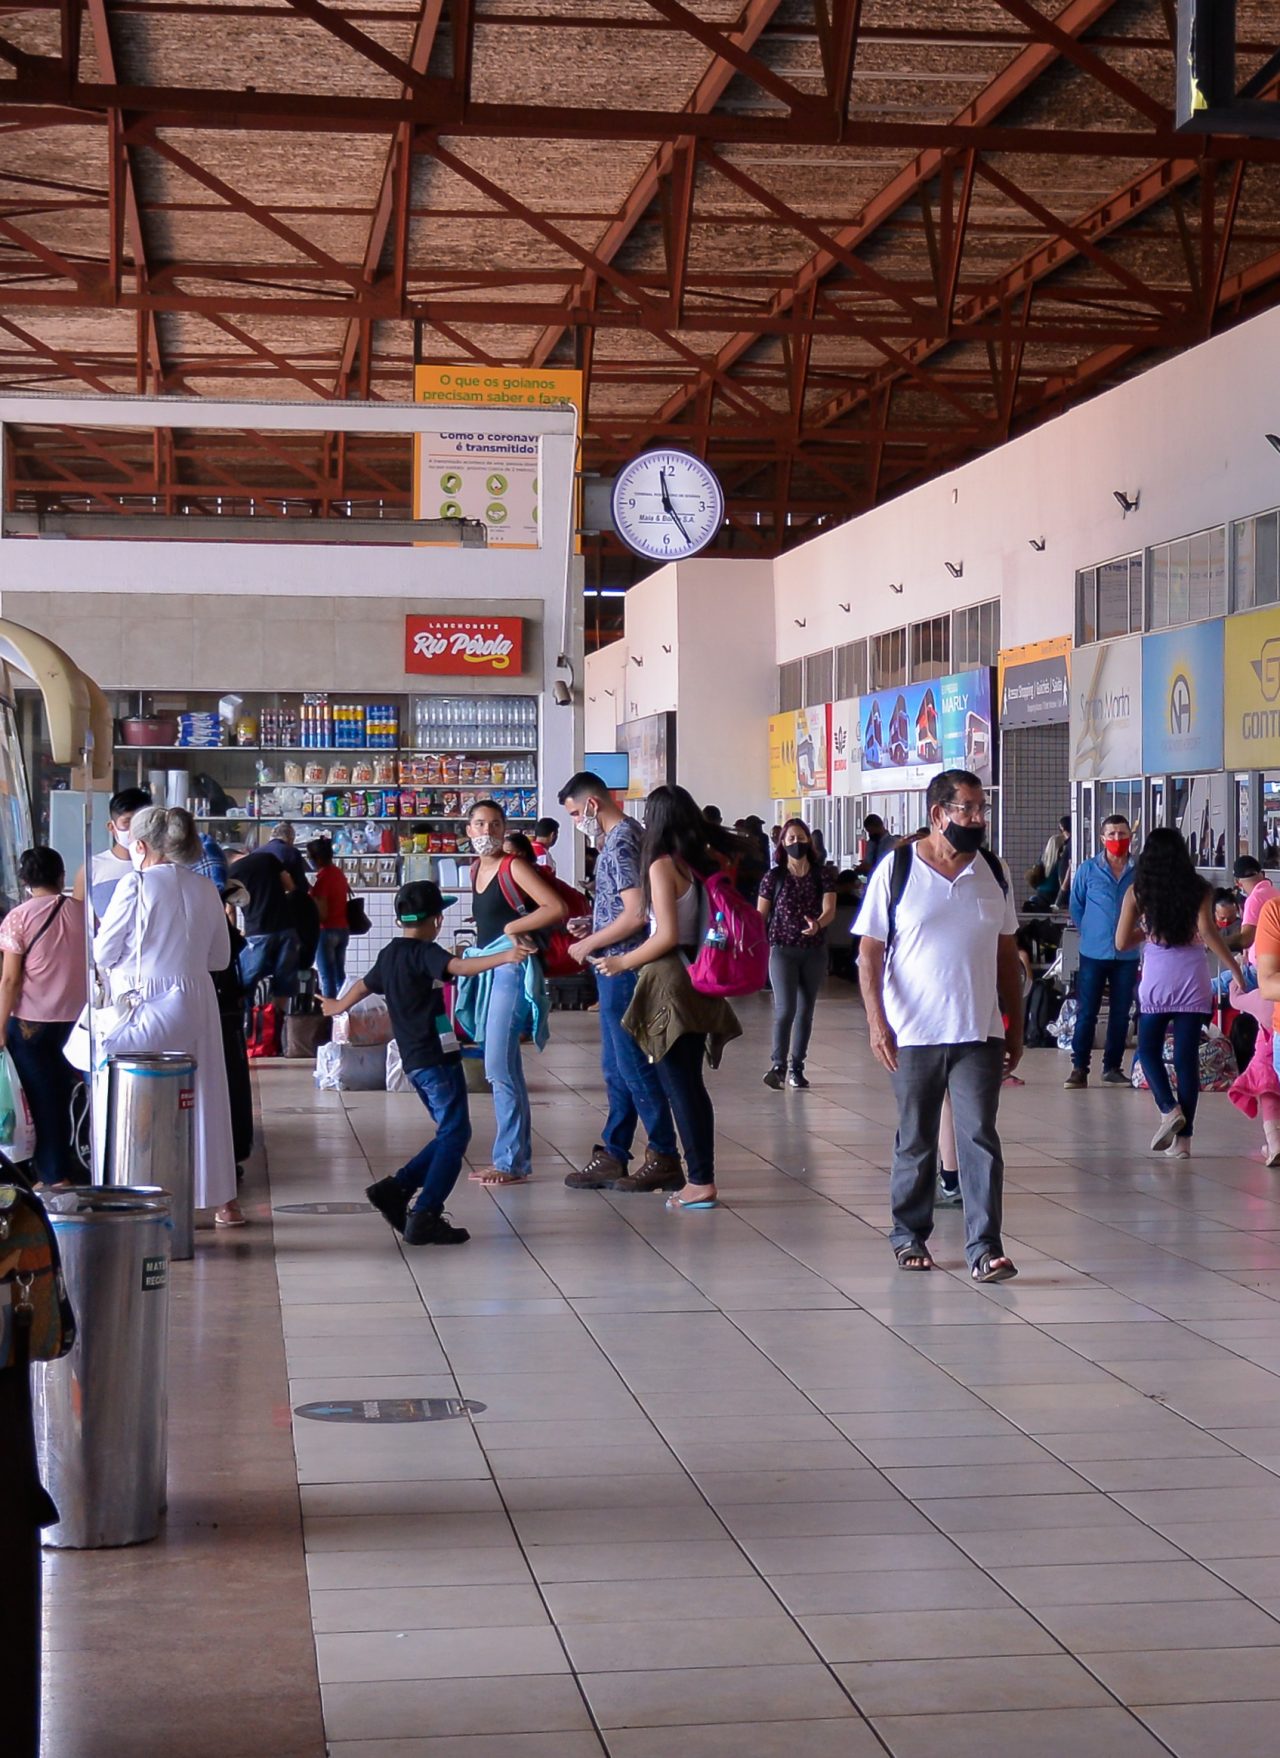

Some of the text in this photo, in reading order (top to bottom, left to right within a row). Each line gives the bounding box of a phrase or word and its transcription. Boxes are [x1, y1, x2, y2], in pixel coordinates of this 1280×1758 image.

[440, 374, 556, 389] O que os goianos
[423, 390, 572, 404] precisam saber e fazer
[456, 443, 462, 452] é
[661, 466, 675, 477] 12
[629, 498, 636, 509] 9
[698, 501, 706, 512] 3
[663, 533, 670, 545] 6
[413, 632, 448, 659] Rio
[942, 694, 969, 714] MARLY
